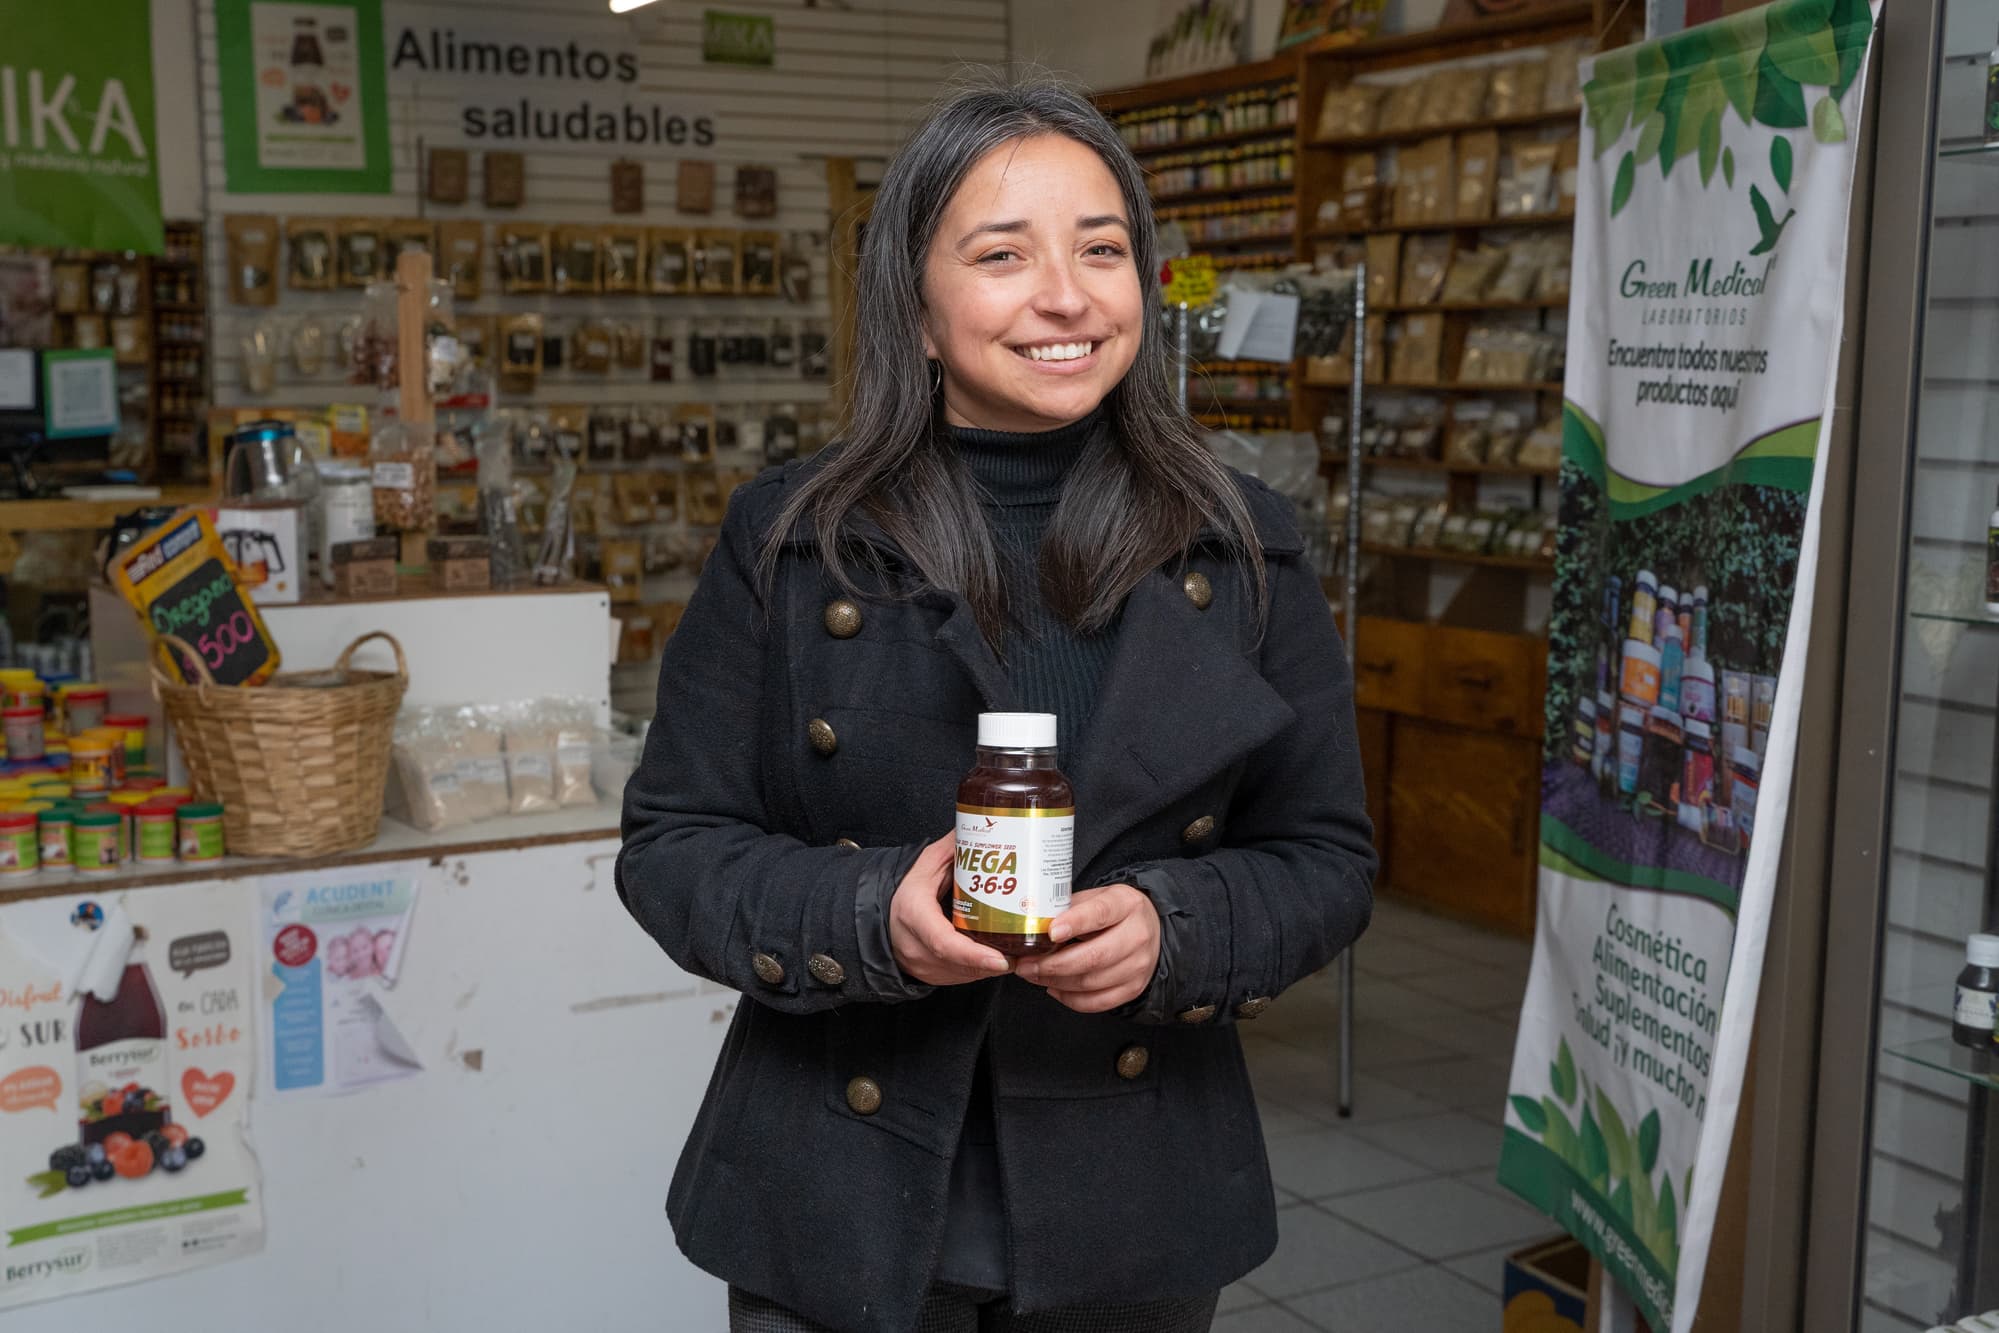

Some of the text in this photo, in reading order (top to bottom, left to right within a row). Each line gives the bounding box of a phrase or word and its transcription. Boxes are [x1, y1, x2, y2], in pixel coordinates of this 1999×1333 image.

[392, 27, 640, 84] Alimentos
[462, 98, 716, 148] saludables
[1620, 259, 1677, 299] Green
[1641, 307, 1748, 325] LABORATORIOS
[1607, 339, 1768, 374] Encuentra todos nuestros
[1636, 378, 1742, 414] productos aquí
[955, 846, 1017, 875] MEGA
[306, 880, 396, 905] ACUDENT
[1606, 902, 1708, 985] Cosmética
[1592, 936, 1717, 1037] Alimentación
[20, 1019, 66, 1048] SUR
[1595, 974, 1711, 1078] Suplementos
[89, 1048, 154, 1067] Berrysur
[1633, 1047, 1696, 1110] mucho
[6, 1253, 85, 1282] Berrysur
